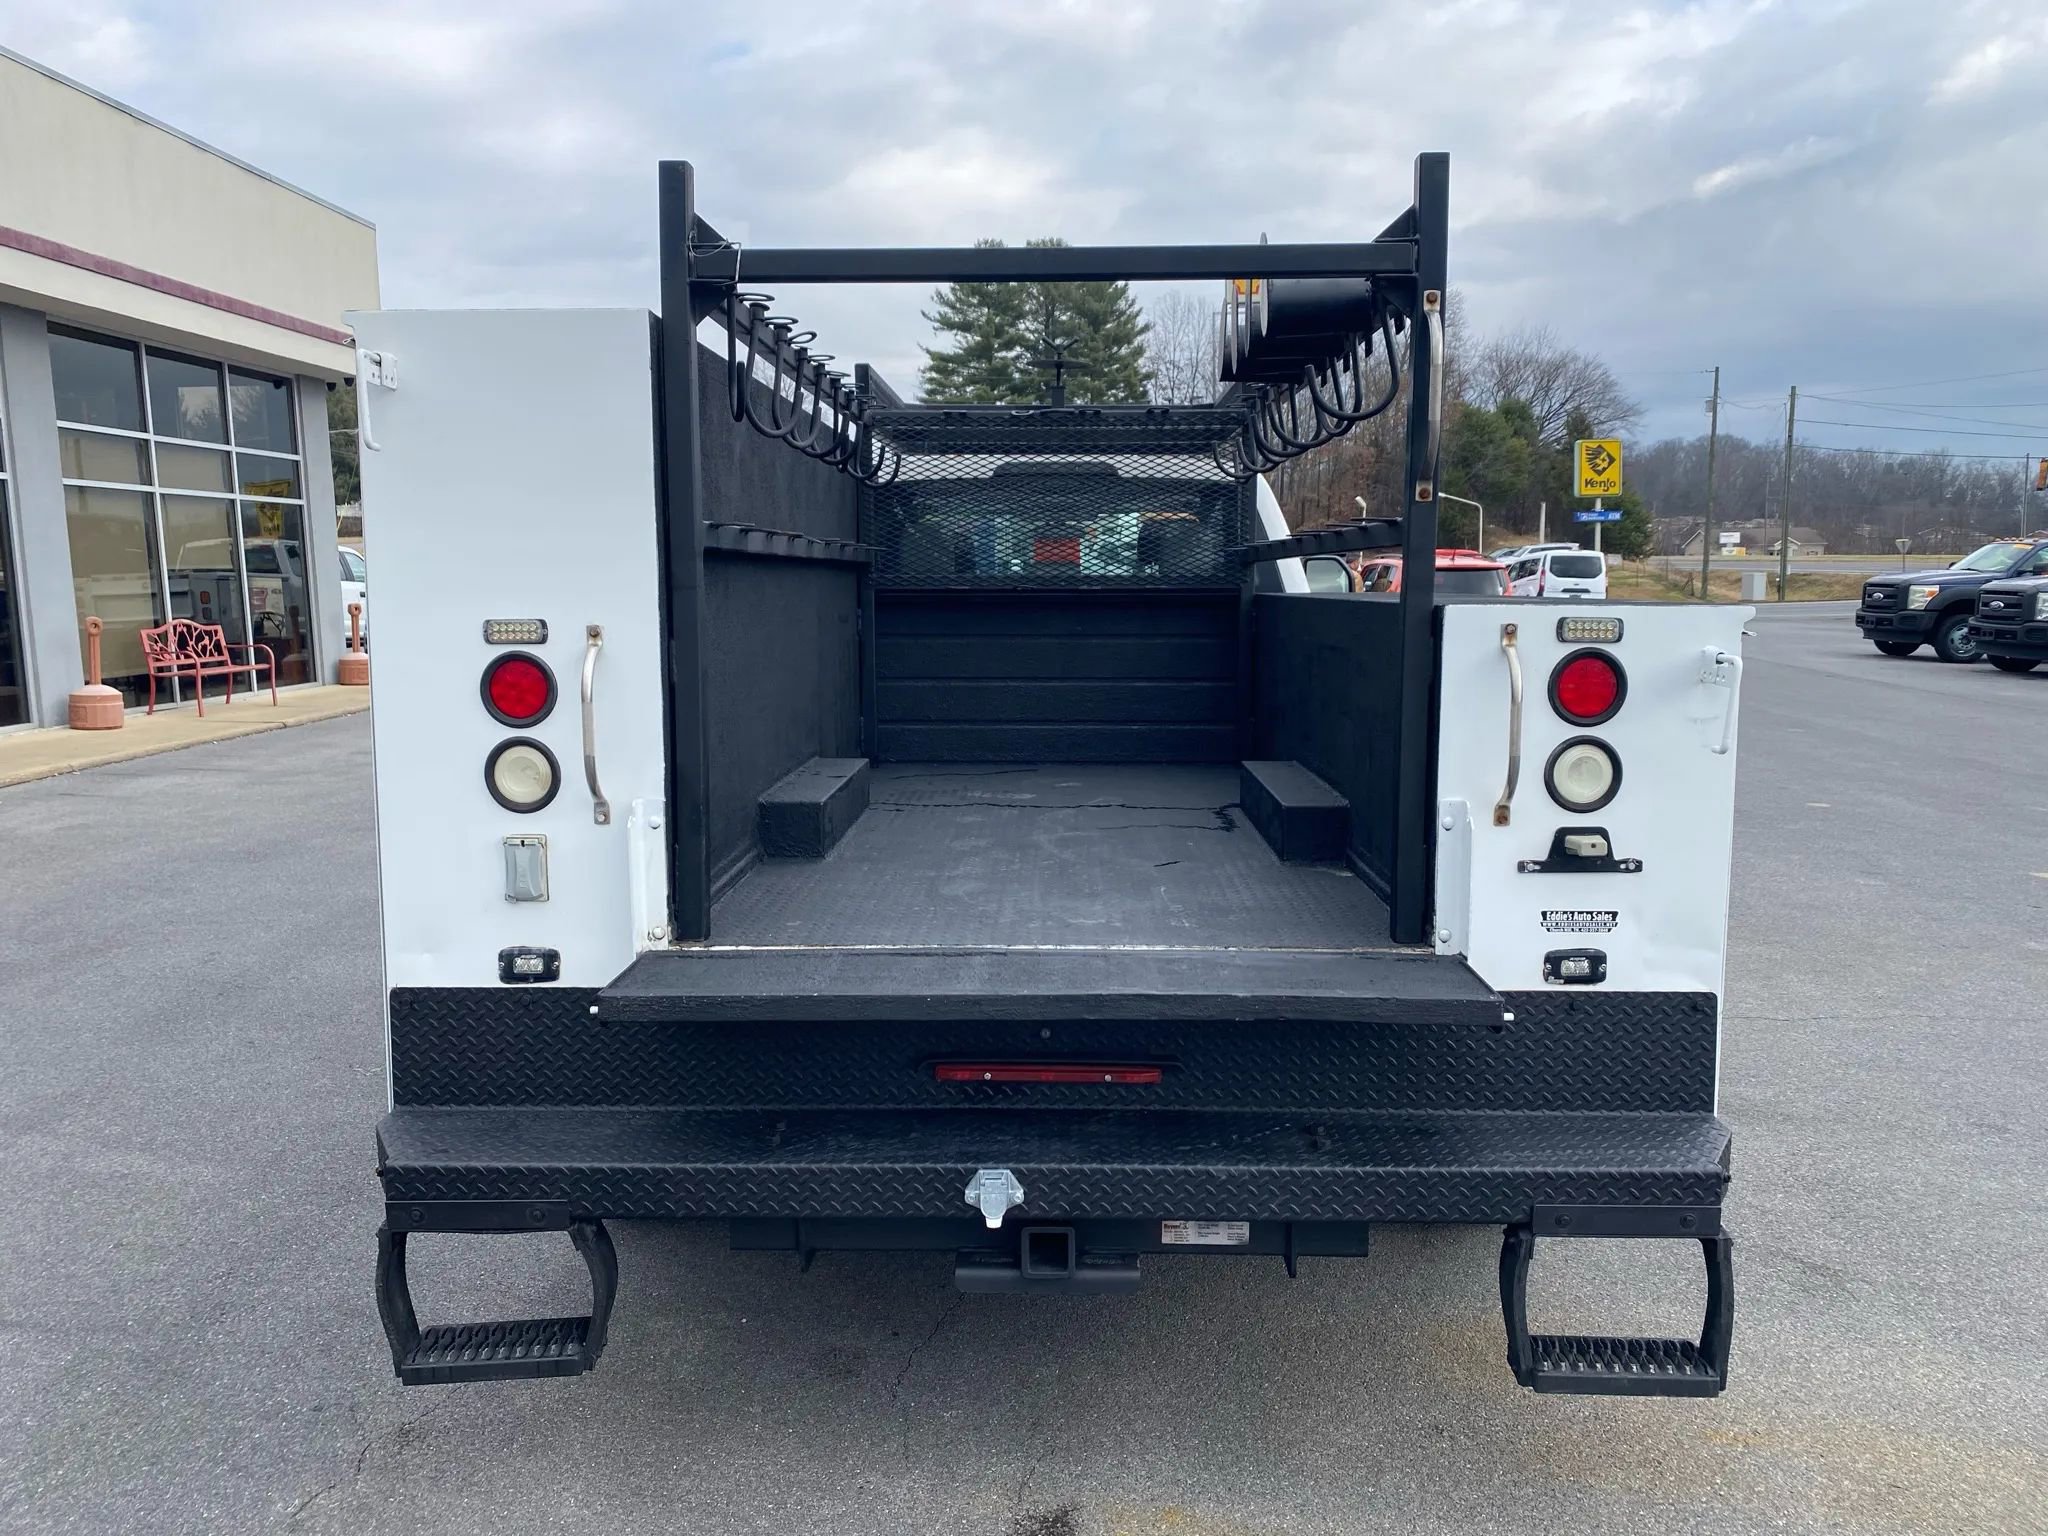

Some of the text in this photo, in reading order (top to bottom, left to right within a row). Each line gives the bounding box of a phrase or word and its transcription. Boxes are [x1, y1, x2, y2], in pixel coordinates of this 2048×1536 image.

[1584, 478, 1616, 492] Kenjo
[1546, 911, 1613, 921] Eddie's Auto Sales
